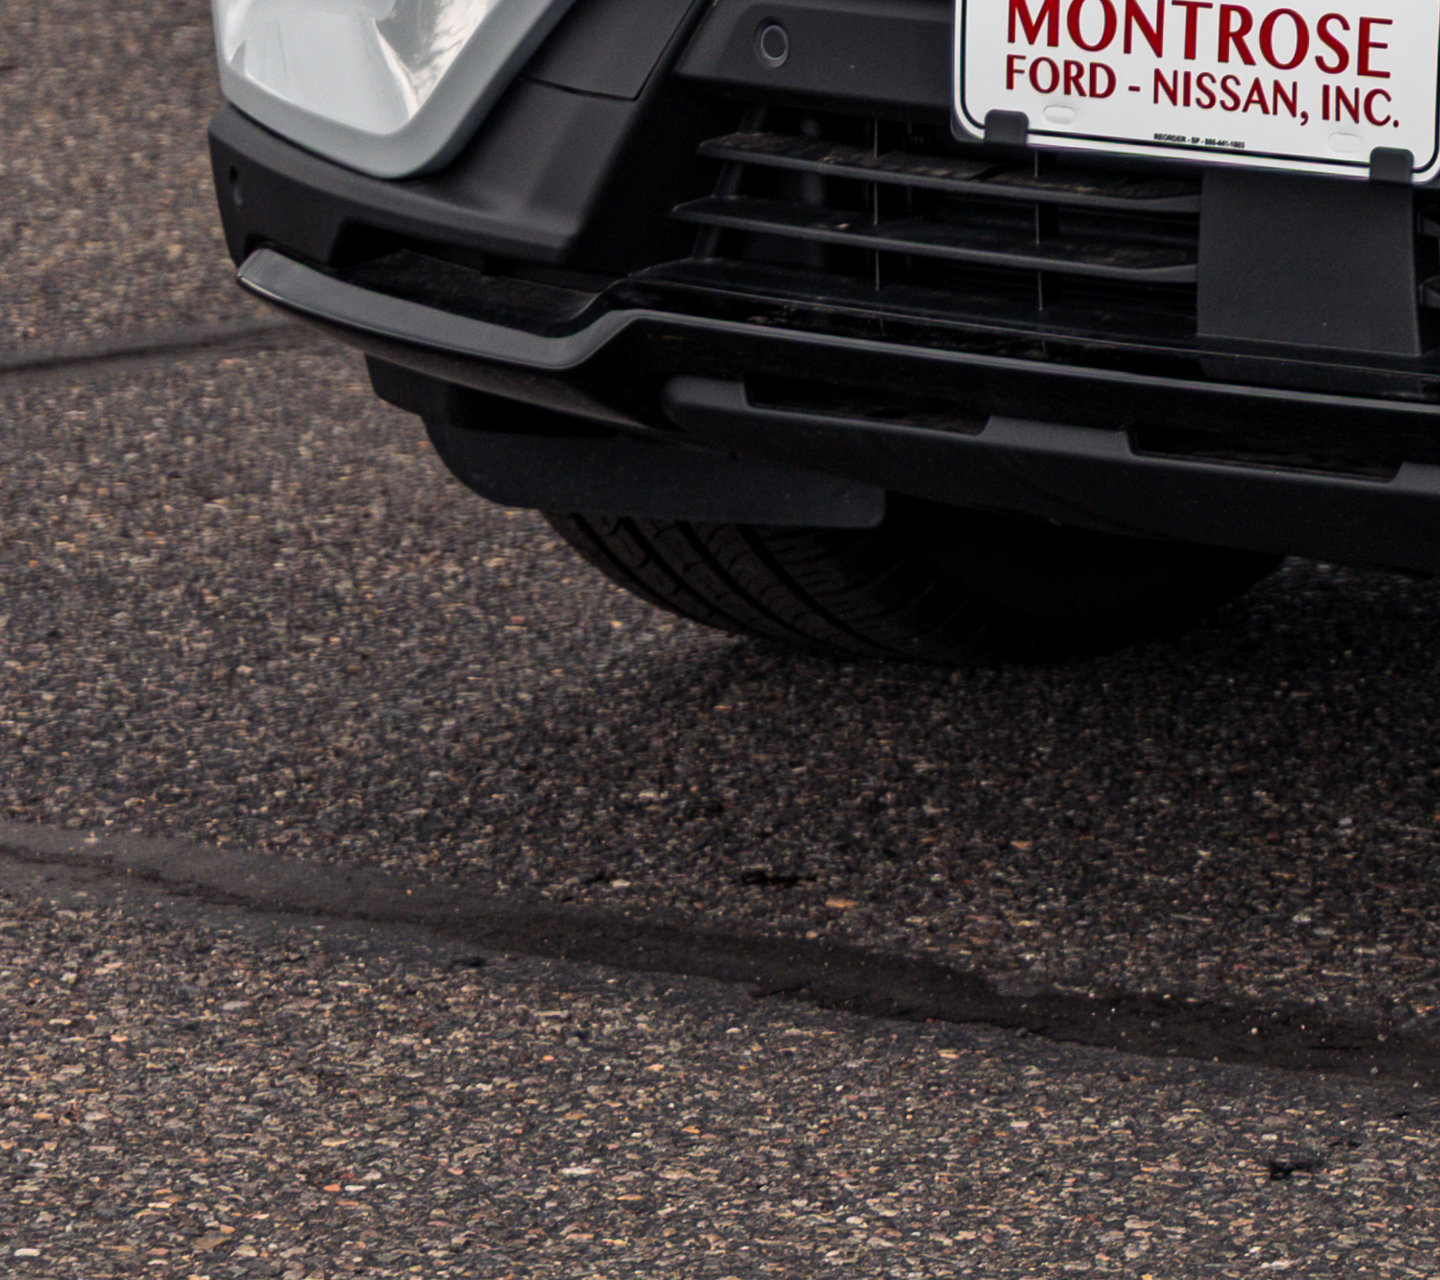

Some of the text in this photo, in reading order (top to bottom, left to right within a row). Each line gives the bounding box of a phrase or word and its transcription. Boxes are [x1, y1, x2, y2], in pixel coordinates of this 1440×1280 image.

[1004, 53, 1117, 100] FORD
[1152, 68, 1310, 127] NISSAN,
[1321, 84, 1400, 129] INC.
